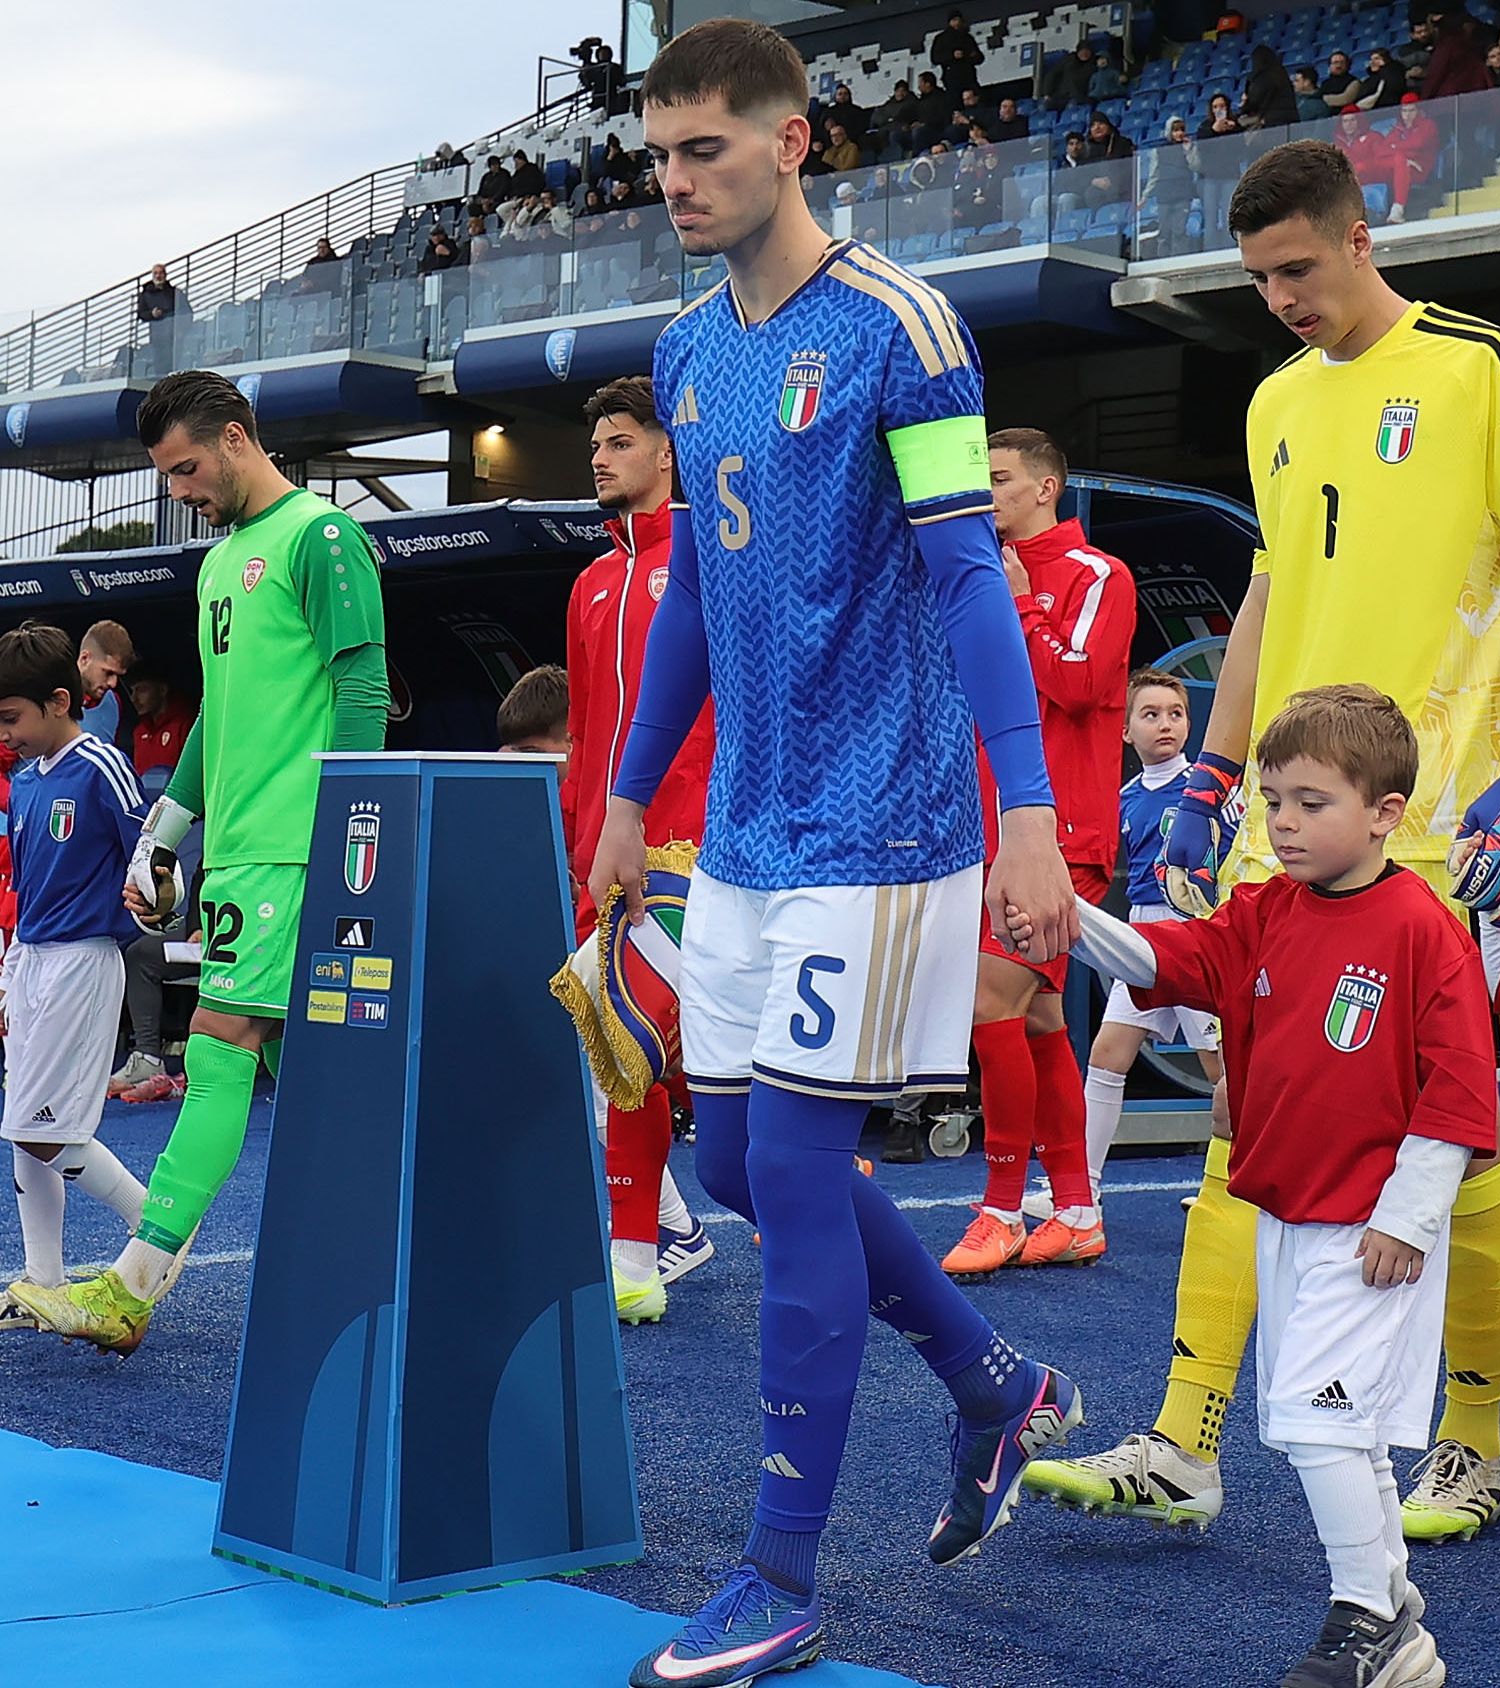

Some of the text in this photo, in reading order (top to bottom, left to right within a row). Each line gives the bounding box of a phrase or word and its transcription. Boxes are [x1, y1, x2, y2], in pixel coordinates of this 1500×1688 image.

[788, 369, 820, 383] ITALIA
[1384, 411, 1413, 422] ITALIA
[717, 455, 751, 551] 5
[1321, 484, 1340, 560] 1
[387, 530, 492, 559] figcstore.com
[89, 567, 176, 590] figcstore.com
[1142, 585, 1217, 607] ITALIA
[209, 596, 233, 656] 12
[350, 822, 376, 837] ITALIA
[201, 900, 244, 965] 12
[315, 961, 331, 977] eni
[789, 954, 846, 1050] 5
[1339, 980, 1378, 1004] ITALIA
[364, 1002, 386, 1021] TIM
[1311, 1398, 1354, 1411] adidas
